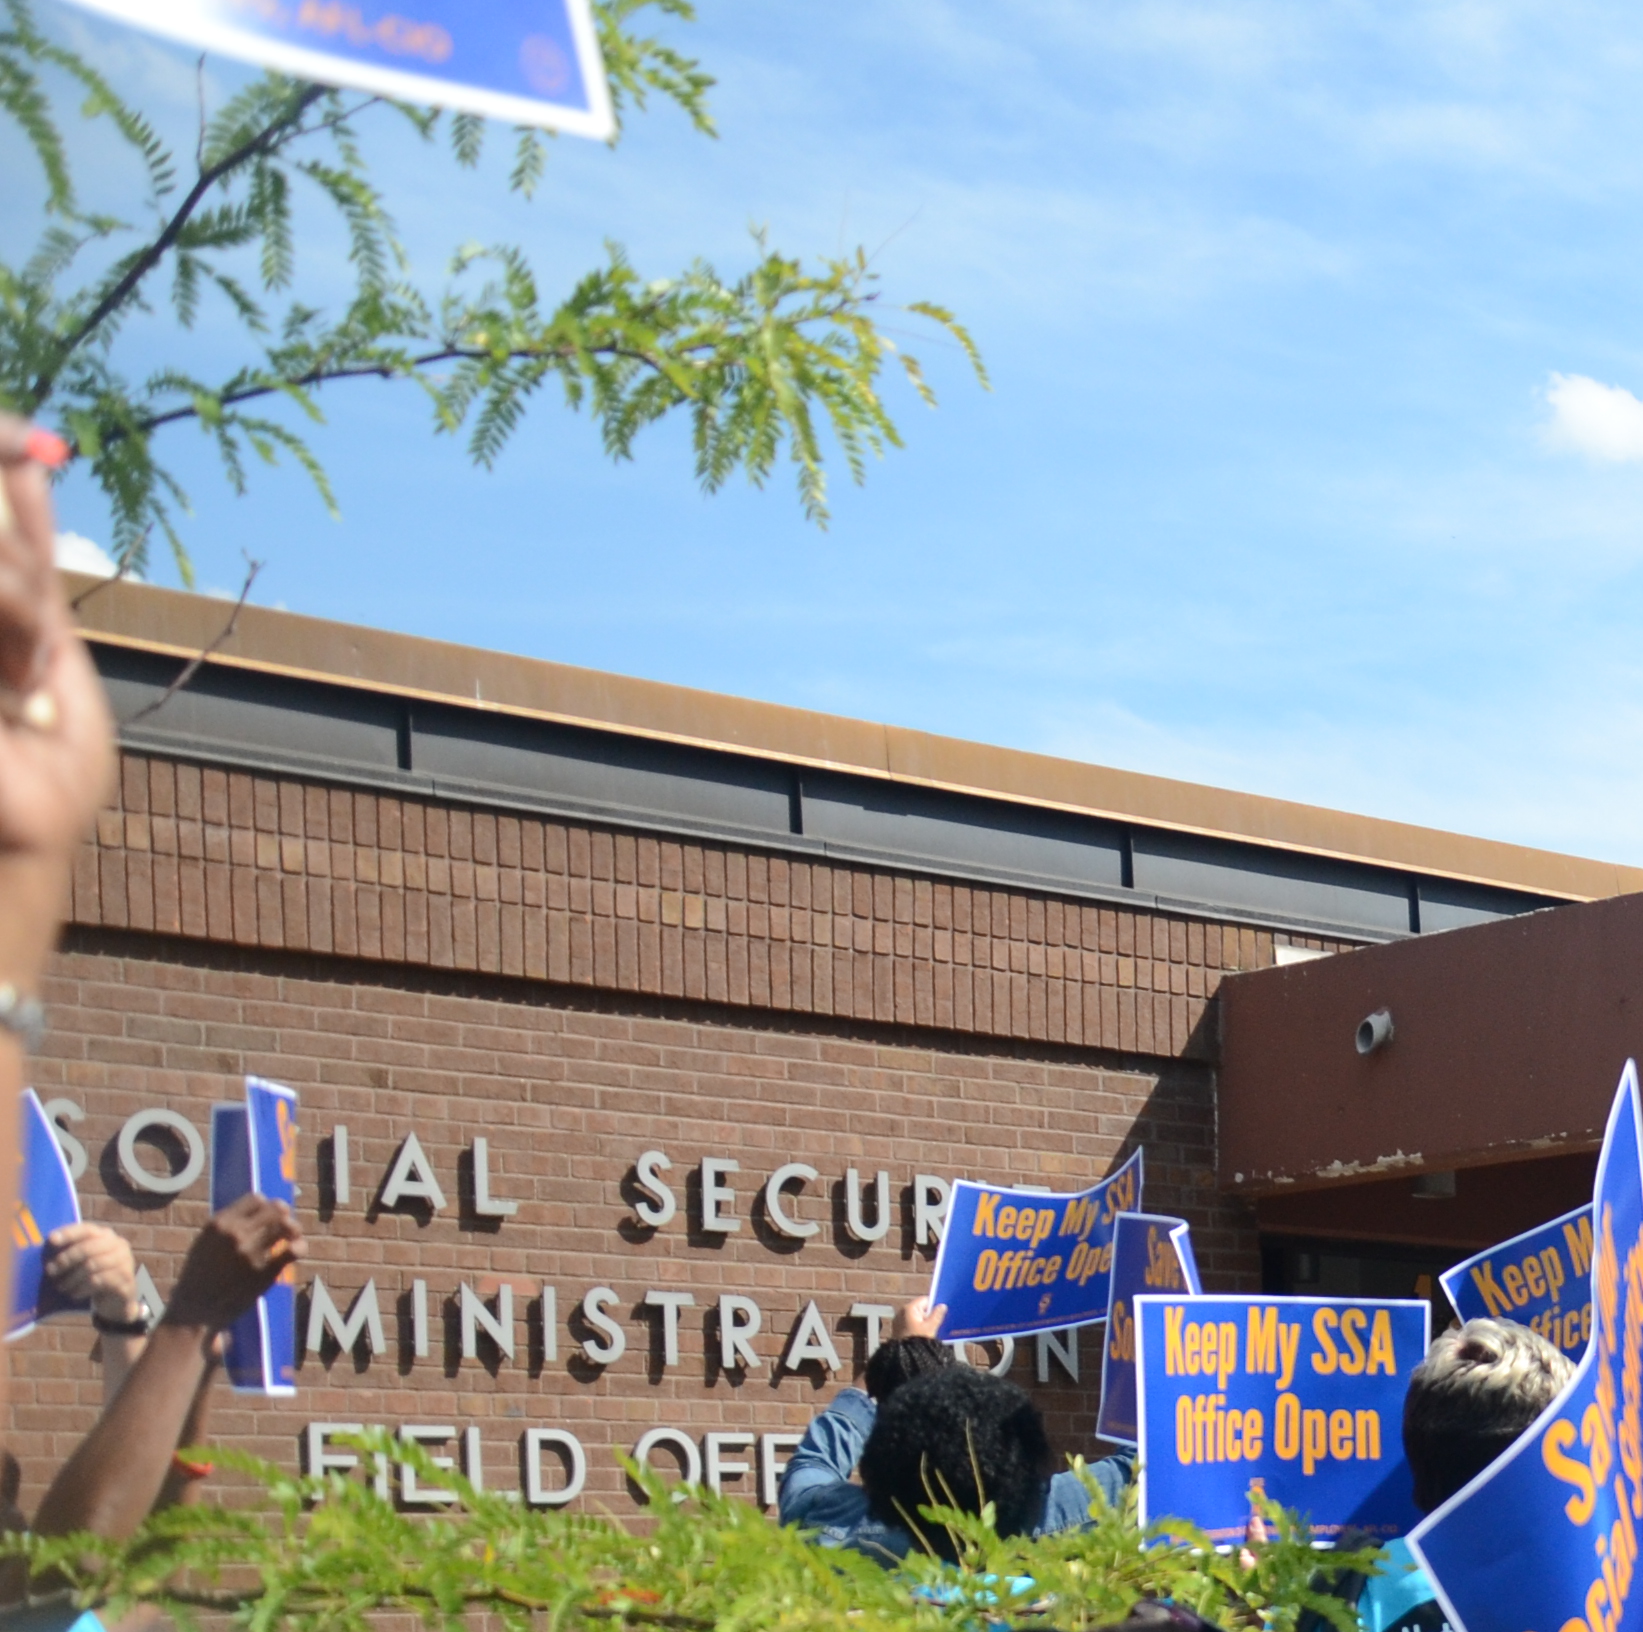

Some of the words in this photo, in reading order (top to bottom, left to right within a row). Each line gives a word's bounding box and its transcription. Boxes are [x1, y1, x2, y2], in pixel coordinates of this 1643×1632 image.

[44, 1098, 518, 1216] SOIAL
[972, 1190, 1056, 1249] Keep
[1057, 1195, 1100, 1242] My
[1100, 1166, 1136, 1226] SSA
[972, 1247, 1063, 1292] Office
[1064, 1240, 1115, 1286] Ope
[1469, 1245, 1566, 1317] Keep
[1561, 1215, 1595, 1278] M
[1163, 1305, 1237, 1388] Keep
[1245, 1306, 1300, 1389] My
[1310, 1307, 1398, 1377] SSA
[1529, 1302, 1592, 1350] ffice
[1174, 1396, 1263, 1465] Office
[1273, 1393, 1381, 1476] Open
